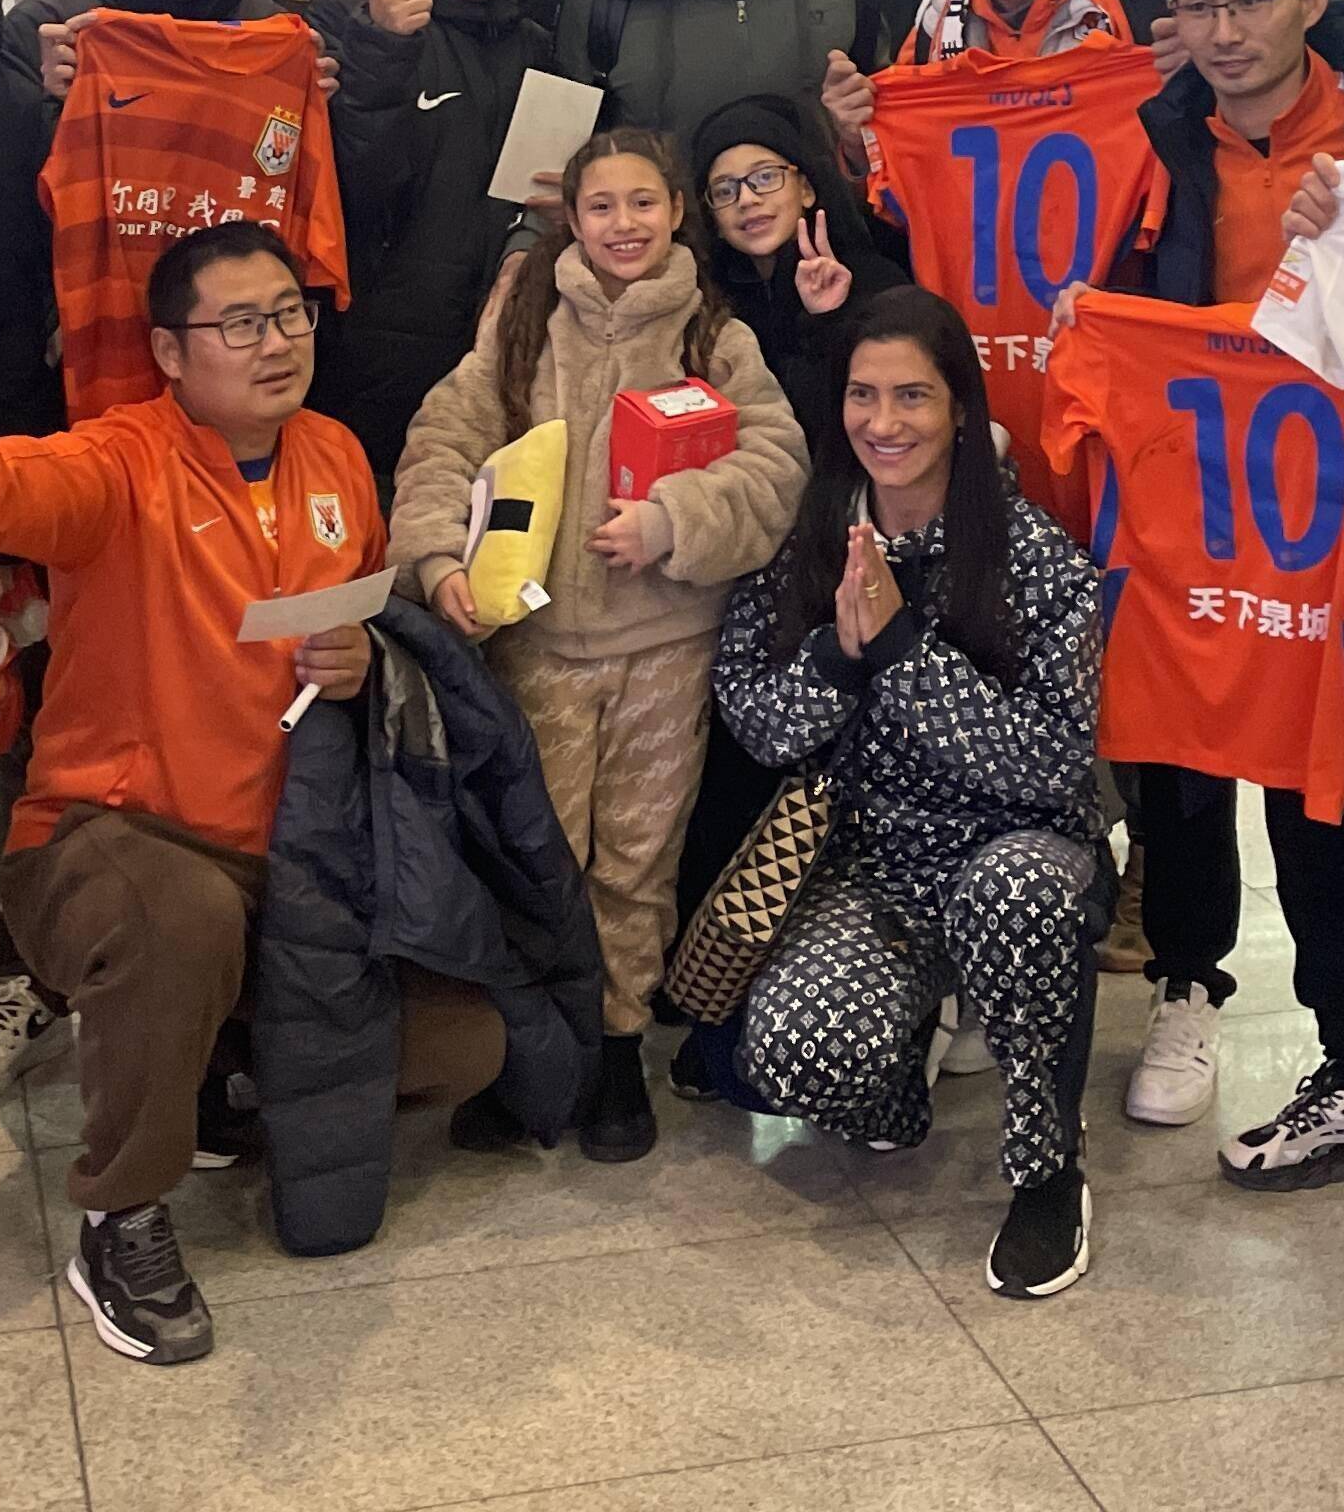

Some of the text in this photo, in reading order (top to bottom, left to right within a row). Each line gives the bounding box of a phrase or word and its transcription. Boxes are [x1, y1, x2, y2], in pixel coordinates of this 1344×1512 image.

[950, 126, 1097, 309] 10
[1188, 587, 1333, 643] 天下泉城
